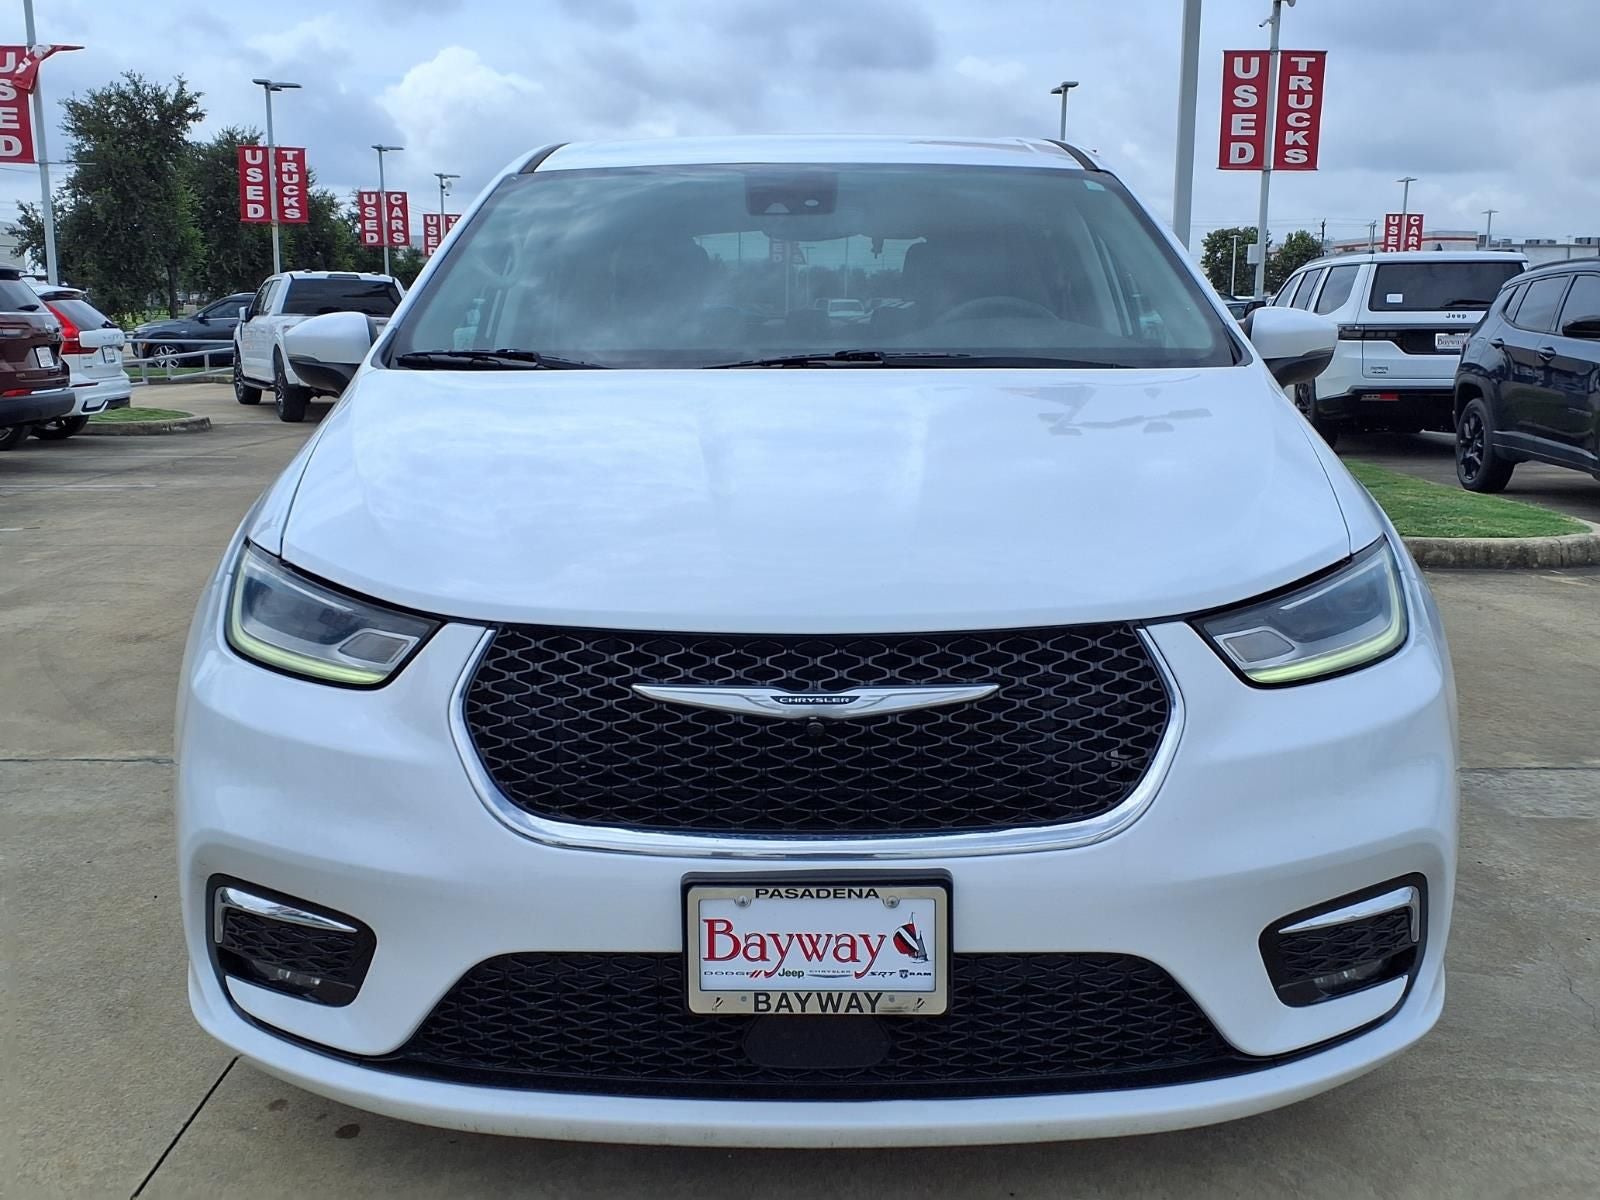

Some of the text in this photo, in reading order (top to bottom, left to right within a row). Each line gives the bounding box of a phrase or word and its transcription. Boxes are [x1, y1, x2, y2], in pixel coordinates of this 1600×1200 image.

[1229, 56, 1260, 164] USED
[1284, 56, 1316, 164] TRUCKS
[244, 149, 265, 218] USED
[281, 150, 301, 219] TRUCKS
[363, 194, 379, 243] USED
[390, 194, 405, 243] CARS
[426, 216, 438, 256] USED
[755, 888, 880, 899] PASADENA
[702, 918, 887, 979] Bayway
[778, 968, 805, 978] Jeep
[753, 992, 883, 1013] BAYWAY
